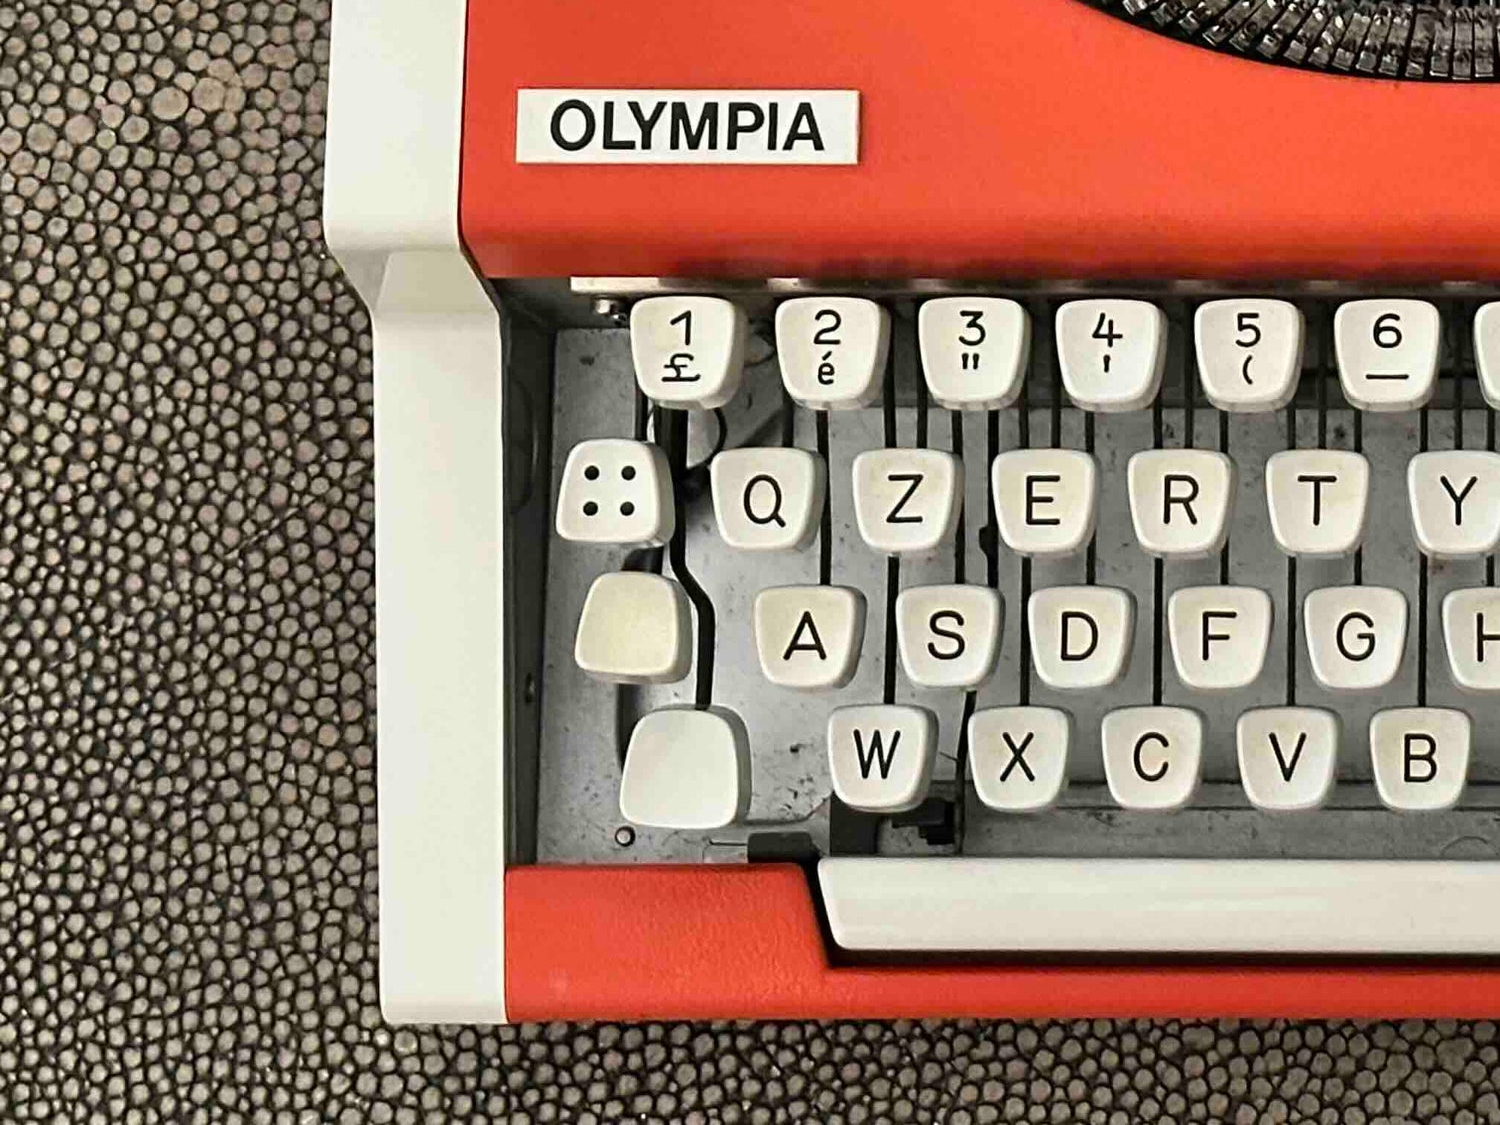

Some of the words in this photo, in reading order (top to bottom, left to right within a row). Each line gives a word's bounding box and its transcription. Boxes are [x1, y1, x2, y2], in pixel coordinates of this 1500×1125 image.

[550, 98, 825, 152] OLYMPIA
[669, 310, 692, 346] 1
[813, 309, 842, 346] 2
[958, 310, 986, 347] 3
[1091, 312, 1124, 348] 4
[1235, 312, 1262, 348] 5
[1372, 312, 1403, 349] 6
[661, 352, 701, 383] £
[817, 350, 835, 386] é
[1242, 354, 1253, 385] (
[743, 474, 787, 528] Q
[885, 473, 924, 524] Z
[1025, 475, 1061, 526] E
[1163, 474, 1200, 526] R
[1297, 475, 1338, 526] T
[1439, 475, 1478, 526] Y
[782, 610, 827, 661] A
[927, 610, 966, 661] S
[1060, 611, 1099, 662] D
[1202, 610, 1238, 661] F
[1336, 611, 1376, 662] G
[853, 728, 901, 780] W
[999, 731, 1036, 783] X
[1133, 731, 1170, 782] C
[1268, 731, 1307, 783] V
[1403, 733, 1438, 783] B
